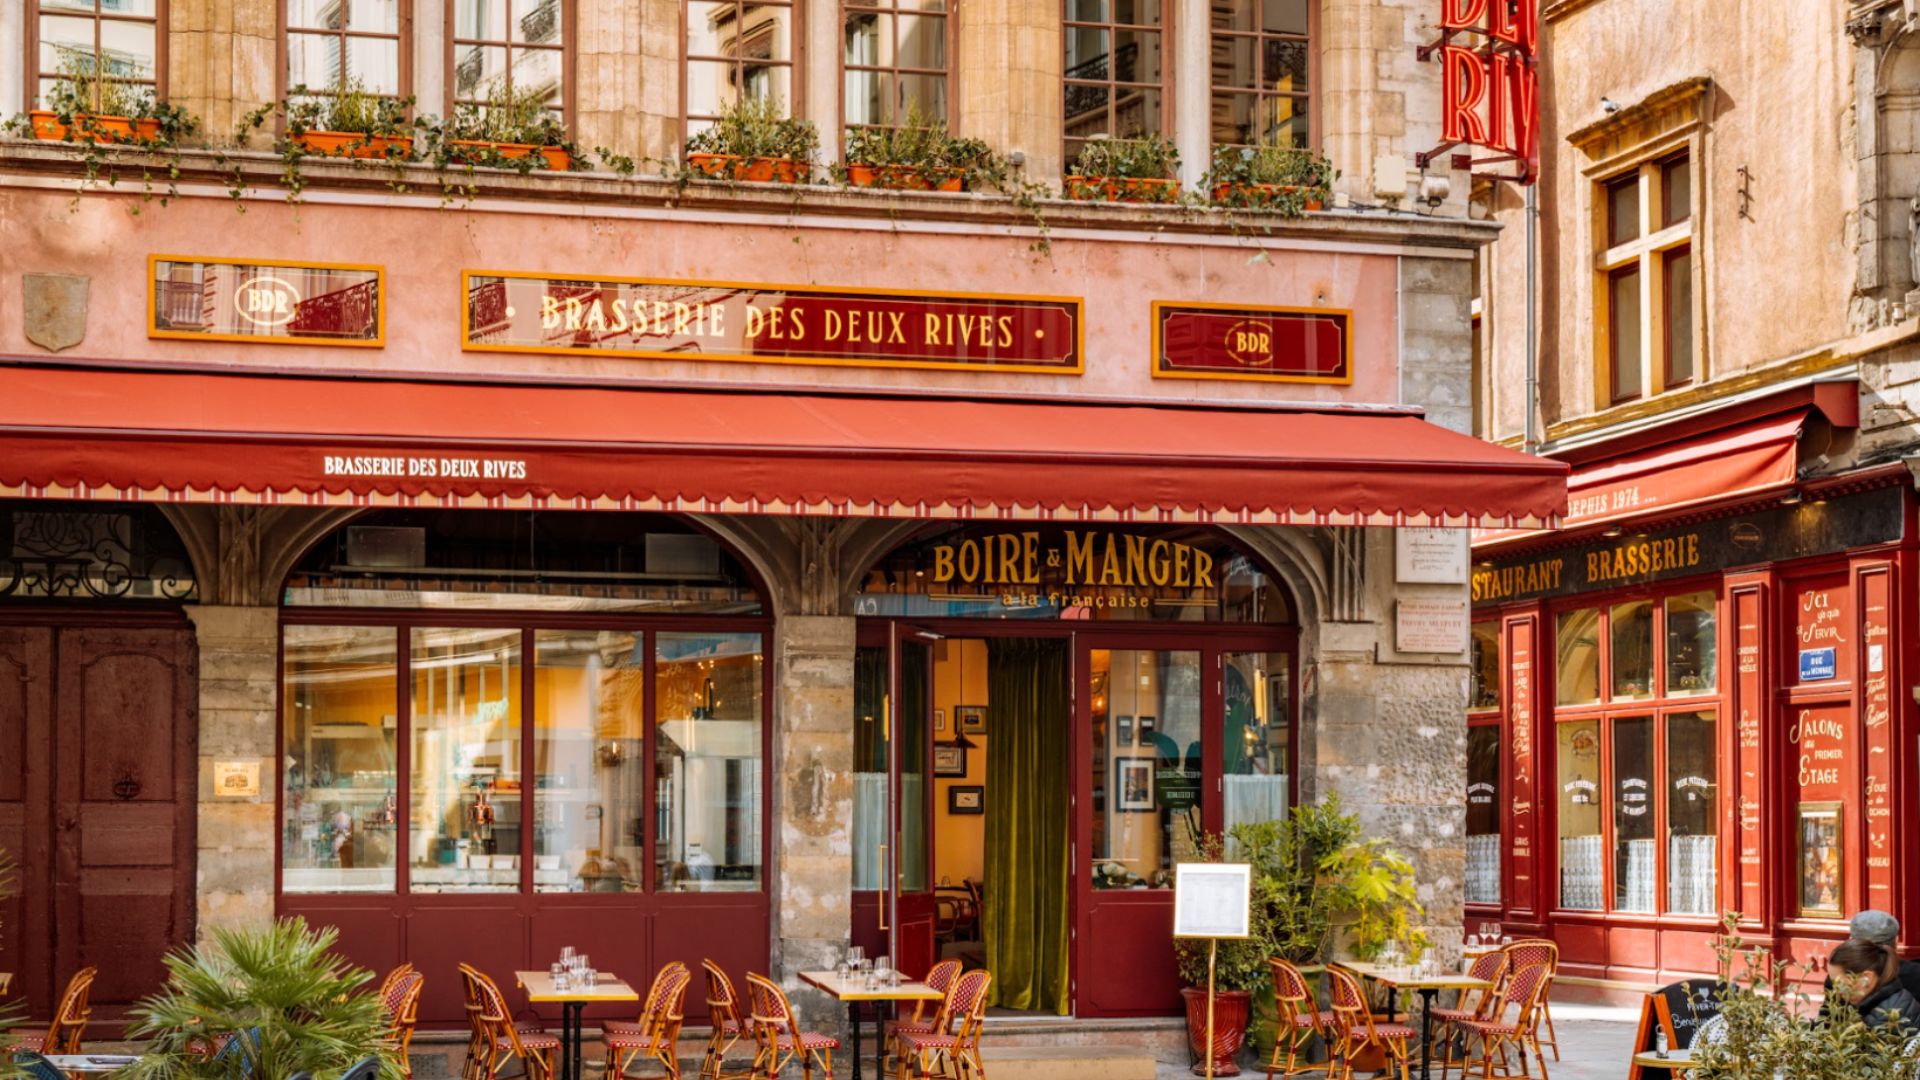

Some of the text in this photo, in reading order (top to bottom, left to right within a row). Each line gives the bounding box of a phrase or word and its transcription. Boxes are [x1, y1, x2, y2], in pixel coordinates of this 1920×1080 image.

[247, 288, 288, 313] BDR
[541, 295, 1014, 348] BRASSERIE DES DEUX RIVES
[1236, 332, 1270, 354] BDR
[323, 456, 526, 479] BRASSERIE DES DEUX RIVES
[1612, 486, 1639, 511] 1974
[934, 530, 1215, 588] BOIRE & MANGER
[1586, 533, 1700, 583] BRASSERIE
[1002, 589, 1149, 609] à la française
